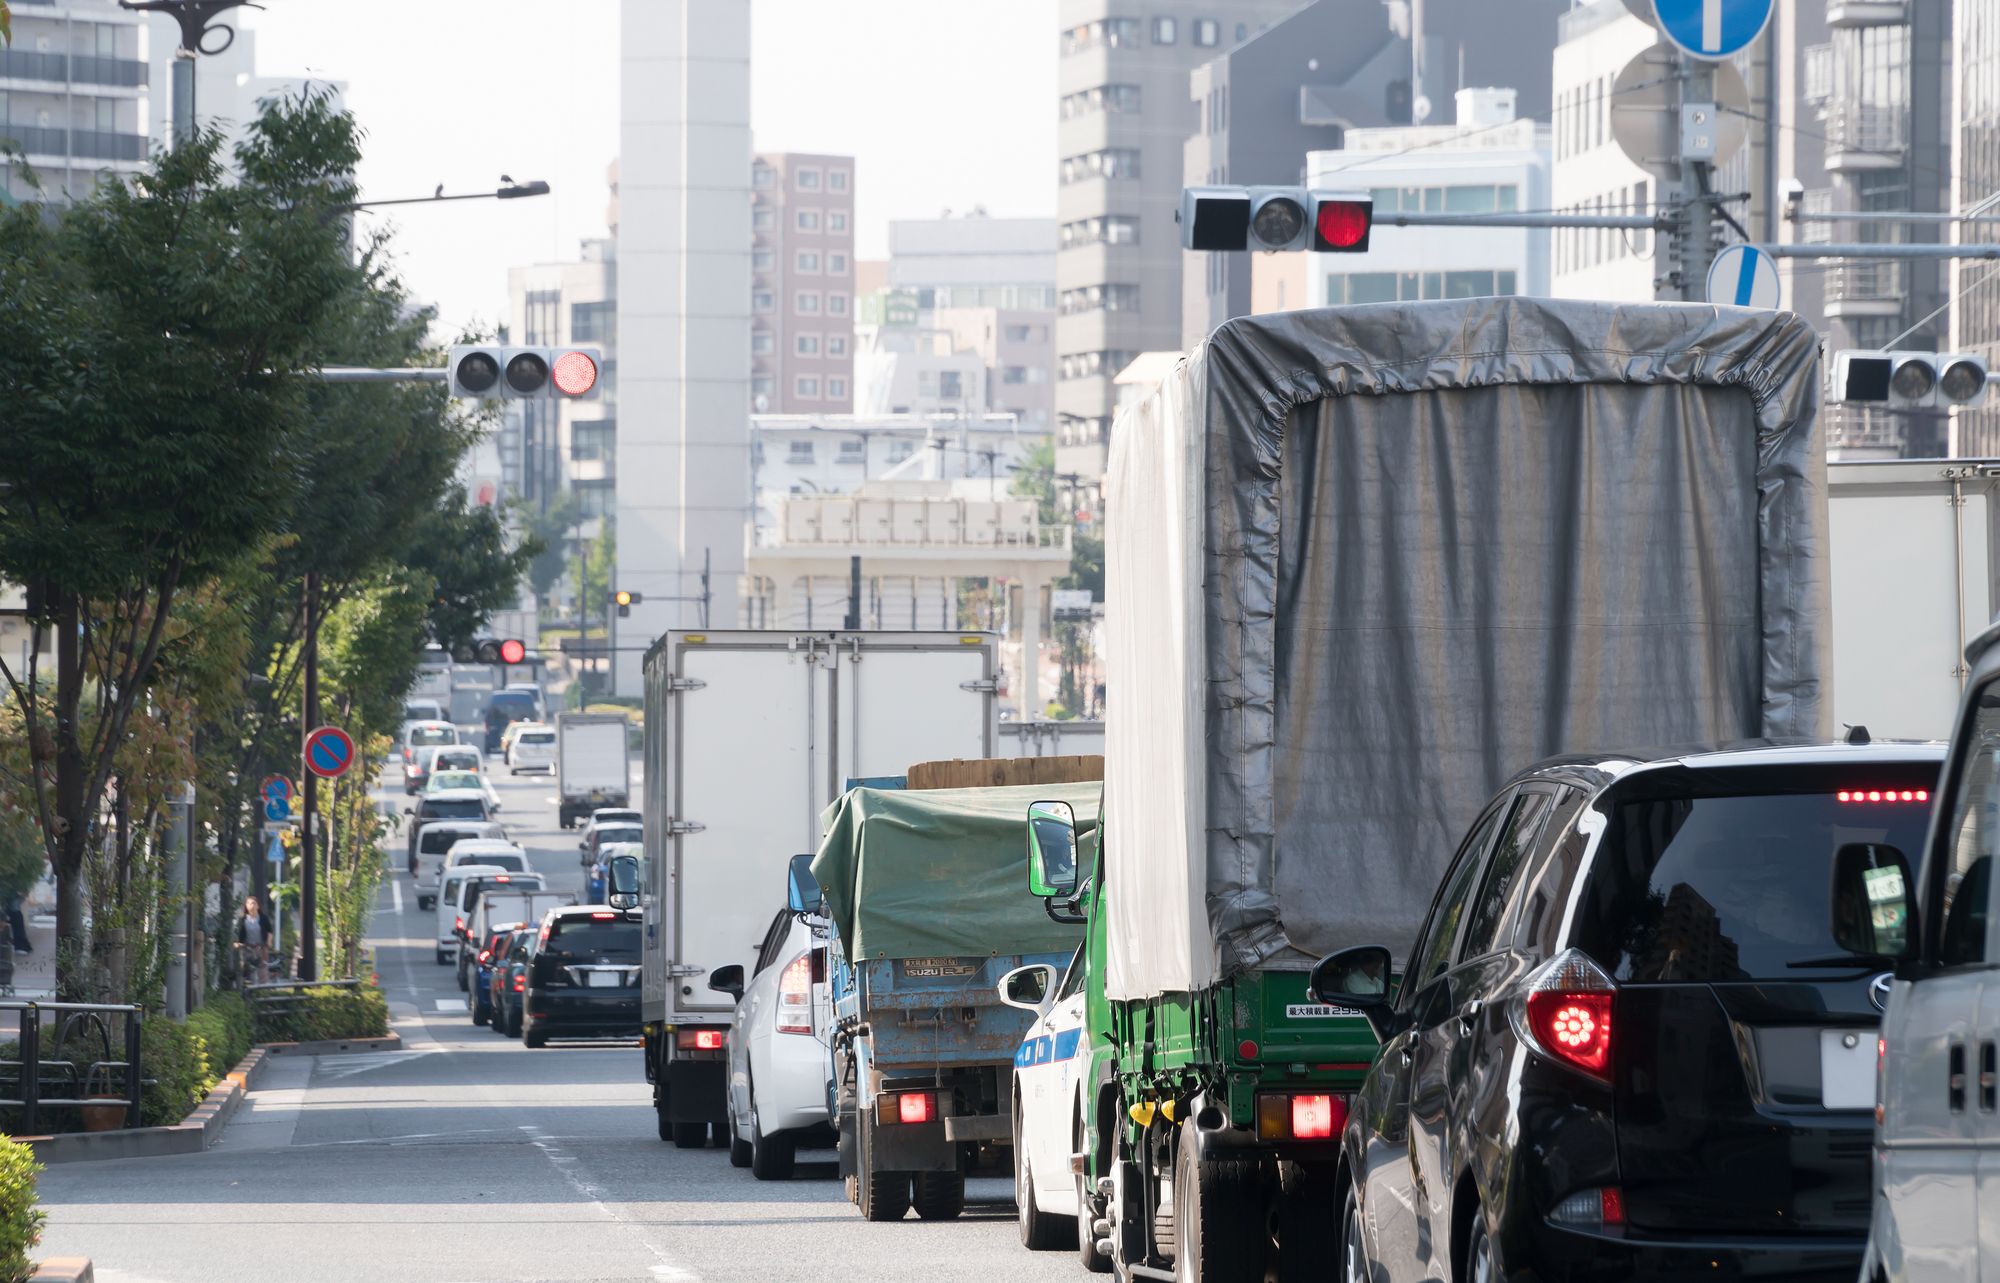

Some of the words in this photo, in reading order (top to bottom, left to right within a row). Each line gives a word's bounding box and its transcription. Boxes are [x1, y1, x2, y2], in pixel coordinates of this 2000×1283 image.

[1289, 1007, 1330, 1015] 最大積載量
